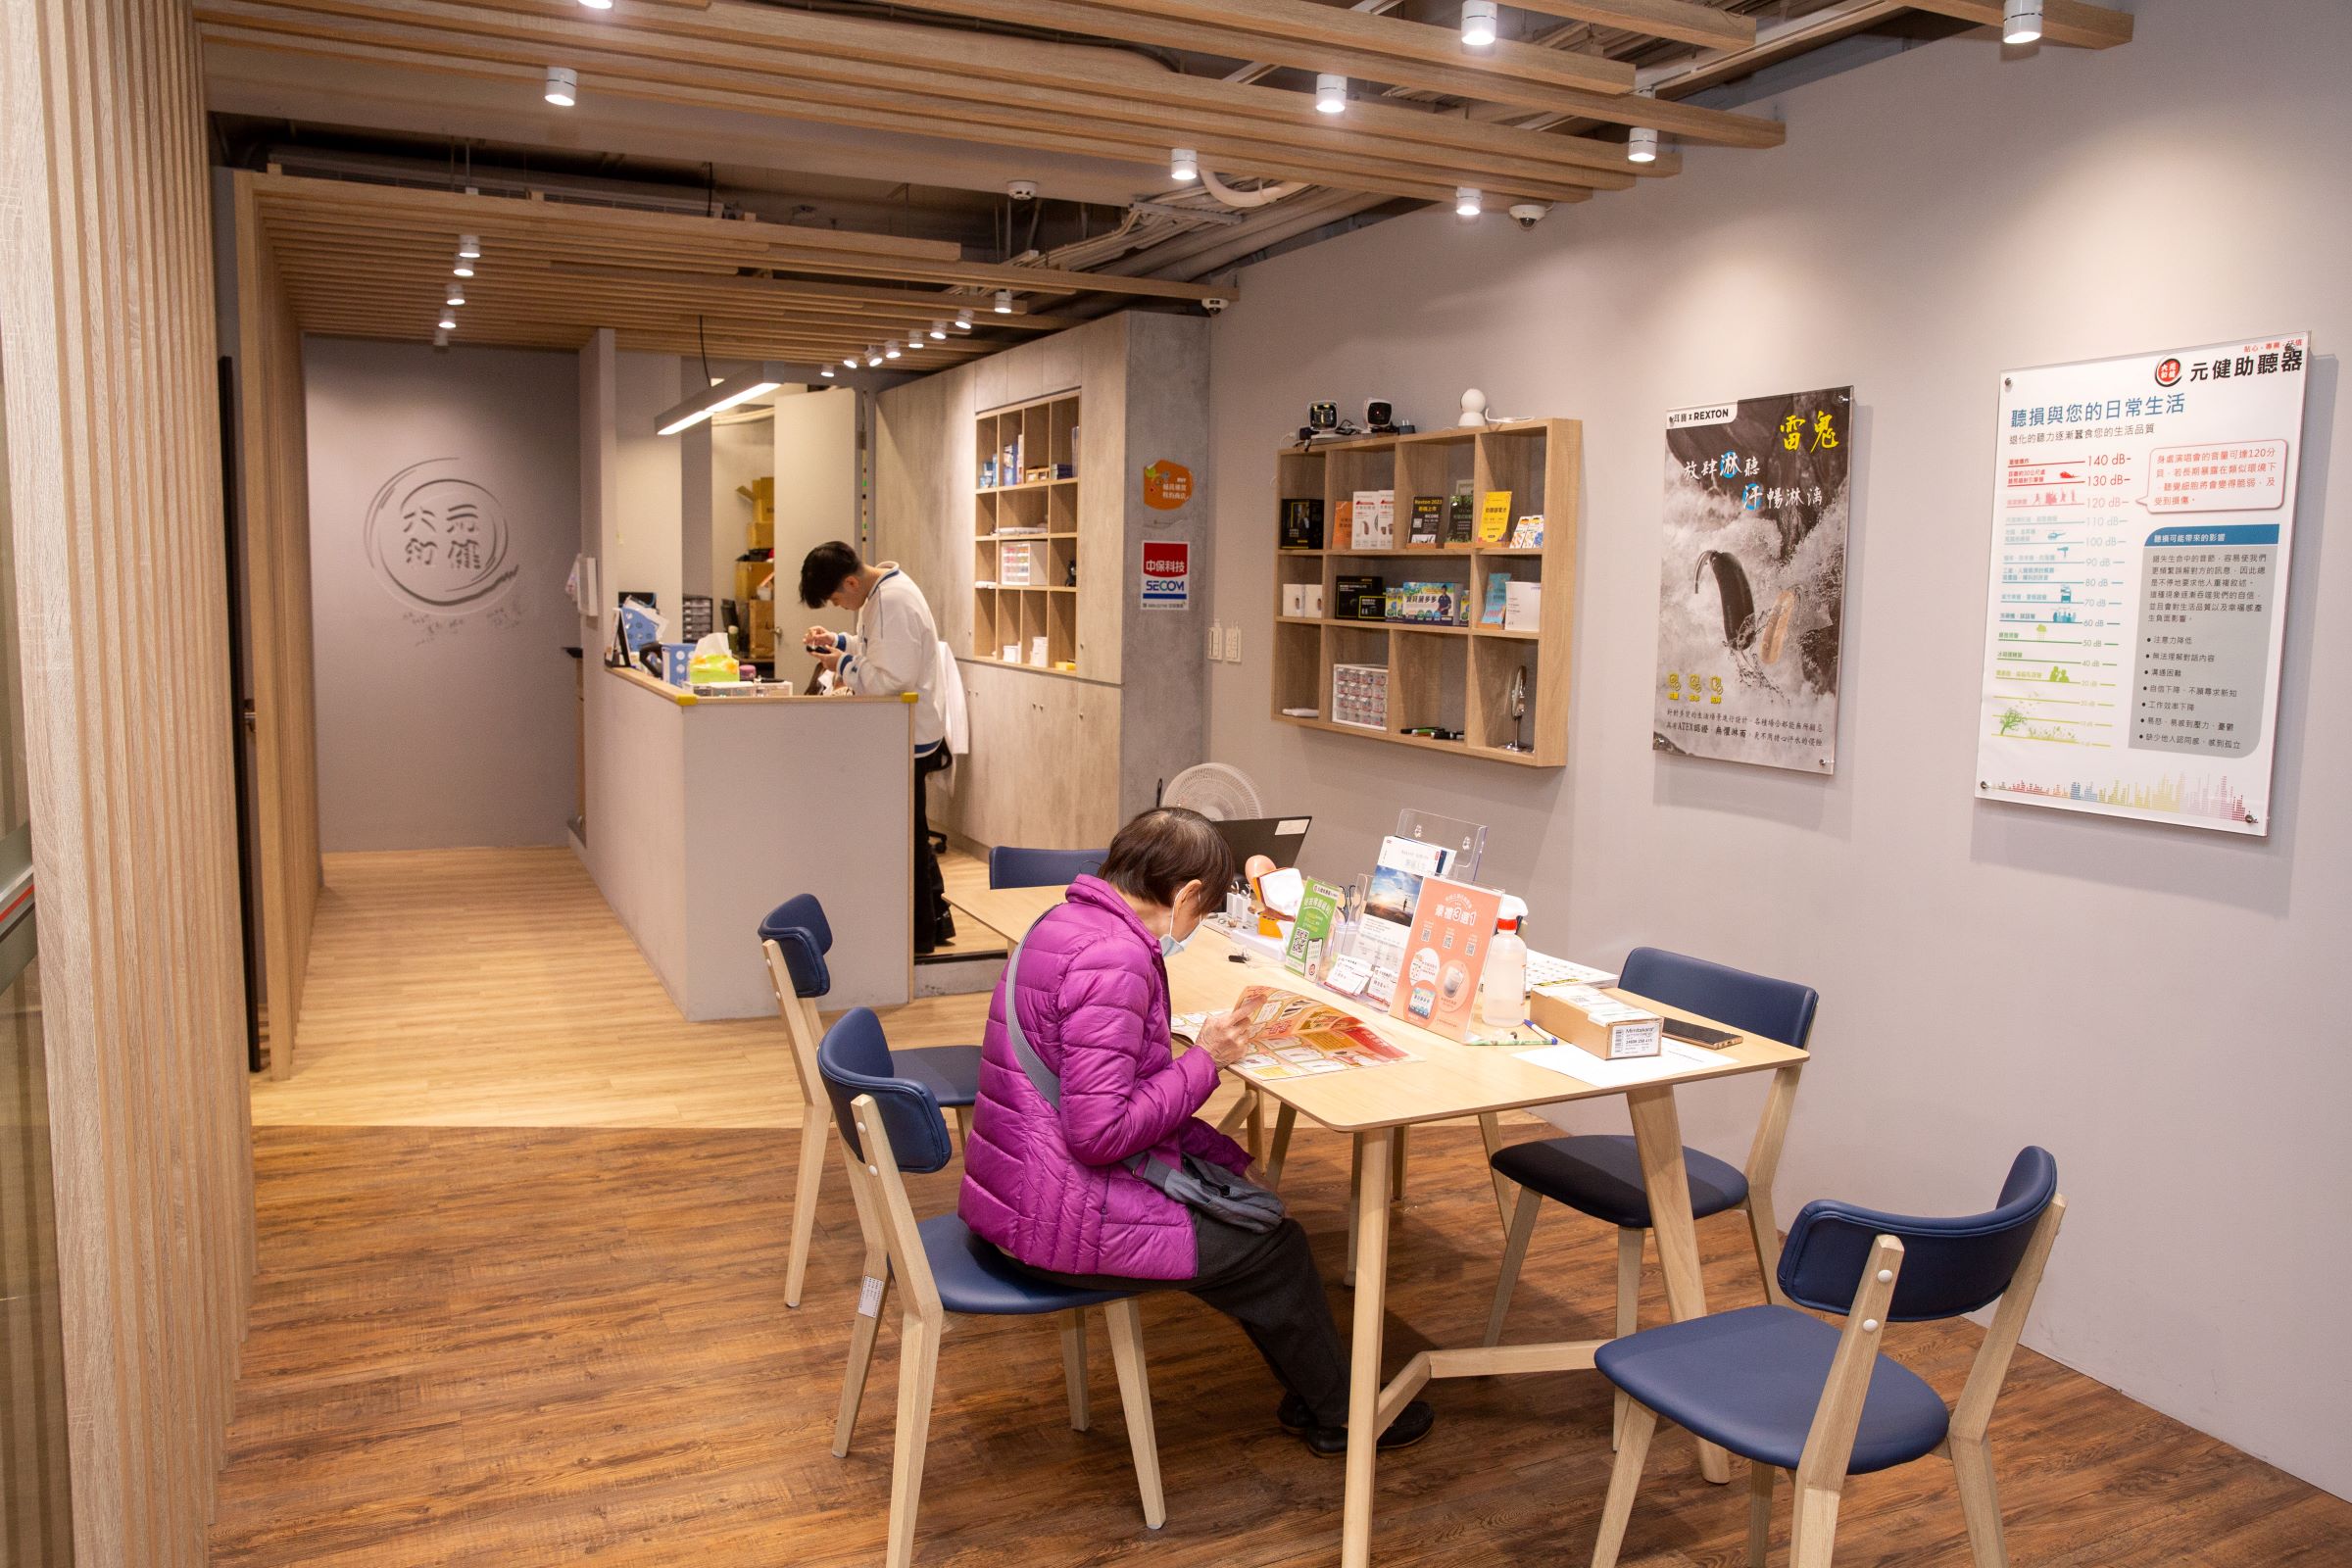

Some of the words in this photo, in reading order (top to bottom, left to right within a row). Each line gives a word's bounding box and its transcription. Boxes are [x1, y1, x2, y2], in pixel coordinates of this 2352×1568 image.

[2190, 350, 2302, 382] 元健助聽器
[1693, 409, 1729, 421] REXTON
[2011, 393, 2185, 428] 聽損與您的日常生活
[1780, 410, 1839, 453] 雷鬼
[2088, 455, 2109, 466] 140
[2087, 476, 2107, 486] 130
[2087, 498, 2105, 509] 120
[2086, 517, 2104, 526] 110
[2086, 537, 2103, 547] 100
[1146, 561, 1185, 572] 中保科技
[1146, 580, 1184, 591] SECOM
[2154, 636, 2192, 645] 注意力降低
[2148, 701, 2195, 711] 工作效率下降
